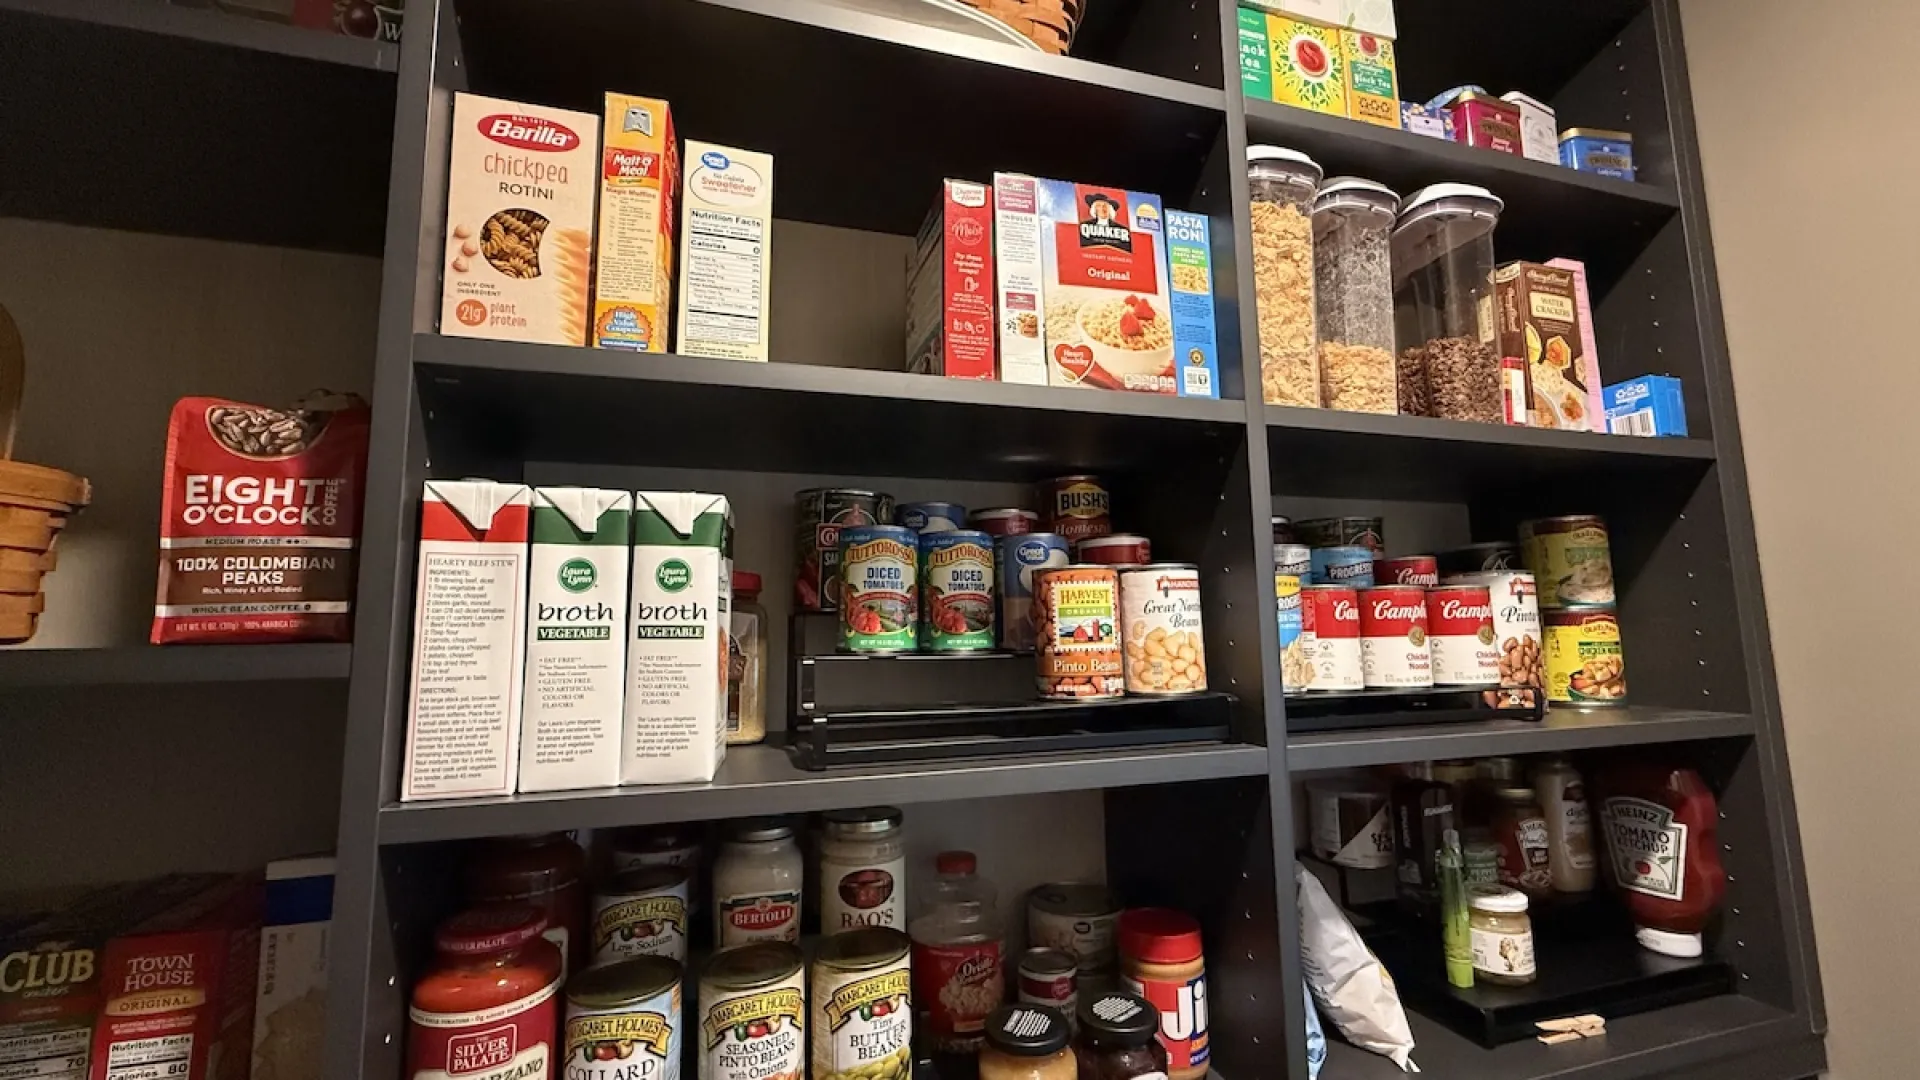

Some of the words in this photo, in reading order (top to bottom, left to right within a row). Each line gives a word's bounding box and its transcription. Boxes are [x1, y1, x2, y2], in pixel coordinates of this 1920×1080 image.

[489, 119, 567, 147] Barilla
[484, 152, 568, 184] chickpea
[499, 181, 554, 200] ROTINI
[692, 211, 733, 223] Nutrition
[735, 217, 761, 228] Facts
[1167, 214, 1204, 230] PASTA
[1080, 223, 1130, 242] QUAKER
[1168, 226, 1205, 243] RONI
[690, 240, 726, 250] Calories
[1087, 266, 1130, 281] Original
[490, 302, 516, 315] plant
[1541, 297, 1564, 308] WATER
[1535, 305, 1571, 317] CRACKERS
[490, 314, 527, 327] protein
[186, 474, 324, 505] EIGHT
[323, 479, 339, 525] COFFEE
[1061, 492, 1108, 510] BUSH'S
[183, 504, 320, 526] O'CLOCK
[177, 557, 219, 572] 100%
[223, 556, 336, 570] COLOMBIAN
[490, 559, 515, 567] STEW
[222, 570, 284, 585] PEAKS
[562, 566, 591, 578] Laura
[659, 566, 687, 577] Laura
[866, 567, 901, 580] DICED
[951, 570, 983, 582] DICED
[568, 575, 593, 586] Lynn
[664, 575, 687, 586] Lynn
[863, 580, 905, 590] TOMATOES
[948, 582, 985, 591] TOMATOES
[1060, 589, 1110, 605] HARVEST
[260, 604, 300, 612] COFFEE
[538, 602, 614, 622] broth
[638, 602, 707, 621] broth
[1143, 599, 1176, 615] Great
[539, 628, 609, 639] VEGETABLE
[639, 626, 704, 638] VEGETABLE
[1053, 659, 1088, 673] Pinto
[1616, 807, 1658, 823] HEINZ
[1613, 821, 1670, 844] TOMATO
[1616, 836, 1669, 854] KETCHUP
[734, 907, 791, 926] BERTOLLI
[840, 908, 894, 928] RAO'S
[612, 941, 634, 952] Low
[636, 935, 673, 951] Sodium
[0, 949, 95, 993] CLUB
[127, 953, 194, 974] TOWN
[124, 970, 195, 993] HOUSE
[837, 979, 887, 1006] MARGARET
[119, 996, 191, 1012] ORIGINAL
[713, 1000, 763, 1022] MARGARET
[871, 1018, 893, 1031] Tiny
[0, 1034, 49, 1049] utrition
[52, 1031, 88, 1042] Facts
[111, 1039, 159, 1052] Nutrition
[161, 1036, 192, 1047] Facts
[455, 1037, 508, 1058] SILVER
[726, 1031, 791, 1055] SEASONED
[719, 1052, 758, 1067] PINTO
[760, 1038, 796, 1064] BEANS
[858, 1037, 904, 1060] BEANS
[65, 1057, 86, 1068] 70
[167, 1063, 188, 1074] 80
[453, 1050, 510, 1071] PALATE
[0, 1067, 40, 1078] alories
[729, 1070, 747, 1080] with
[749, 1058, 788, 1079] Onions
